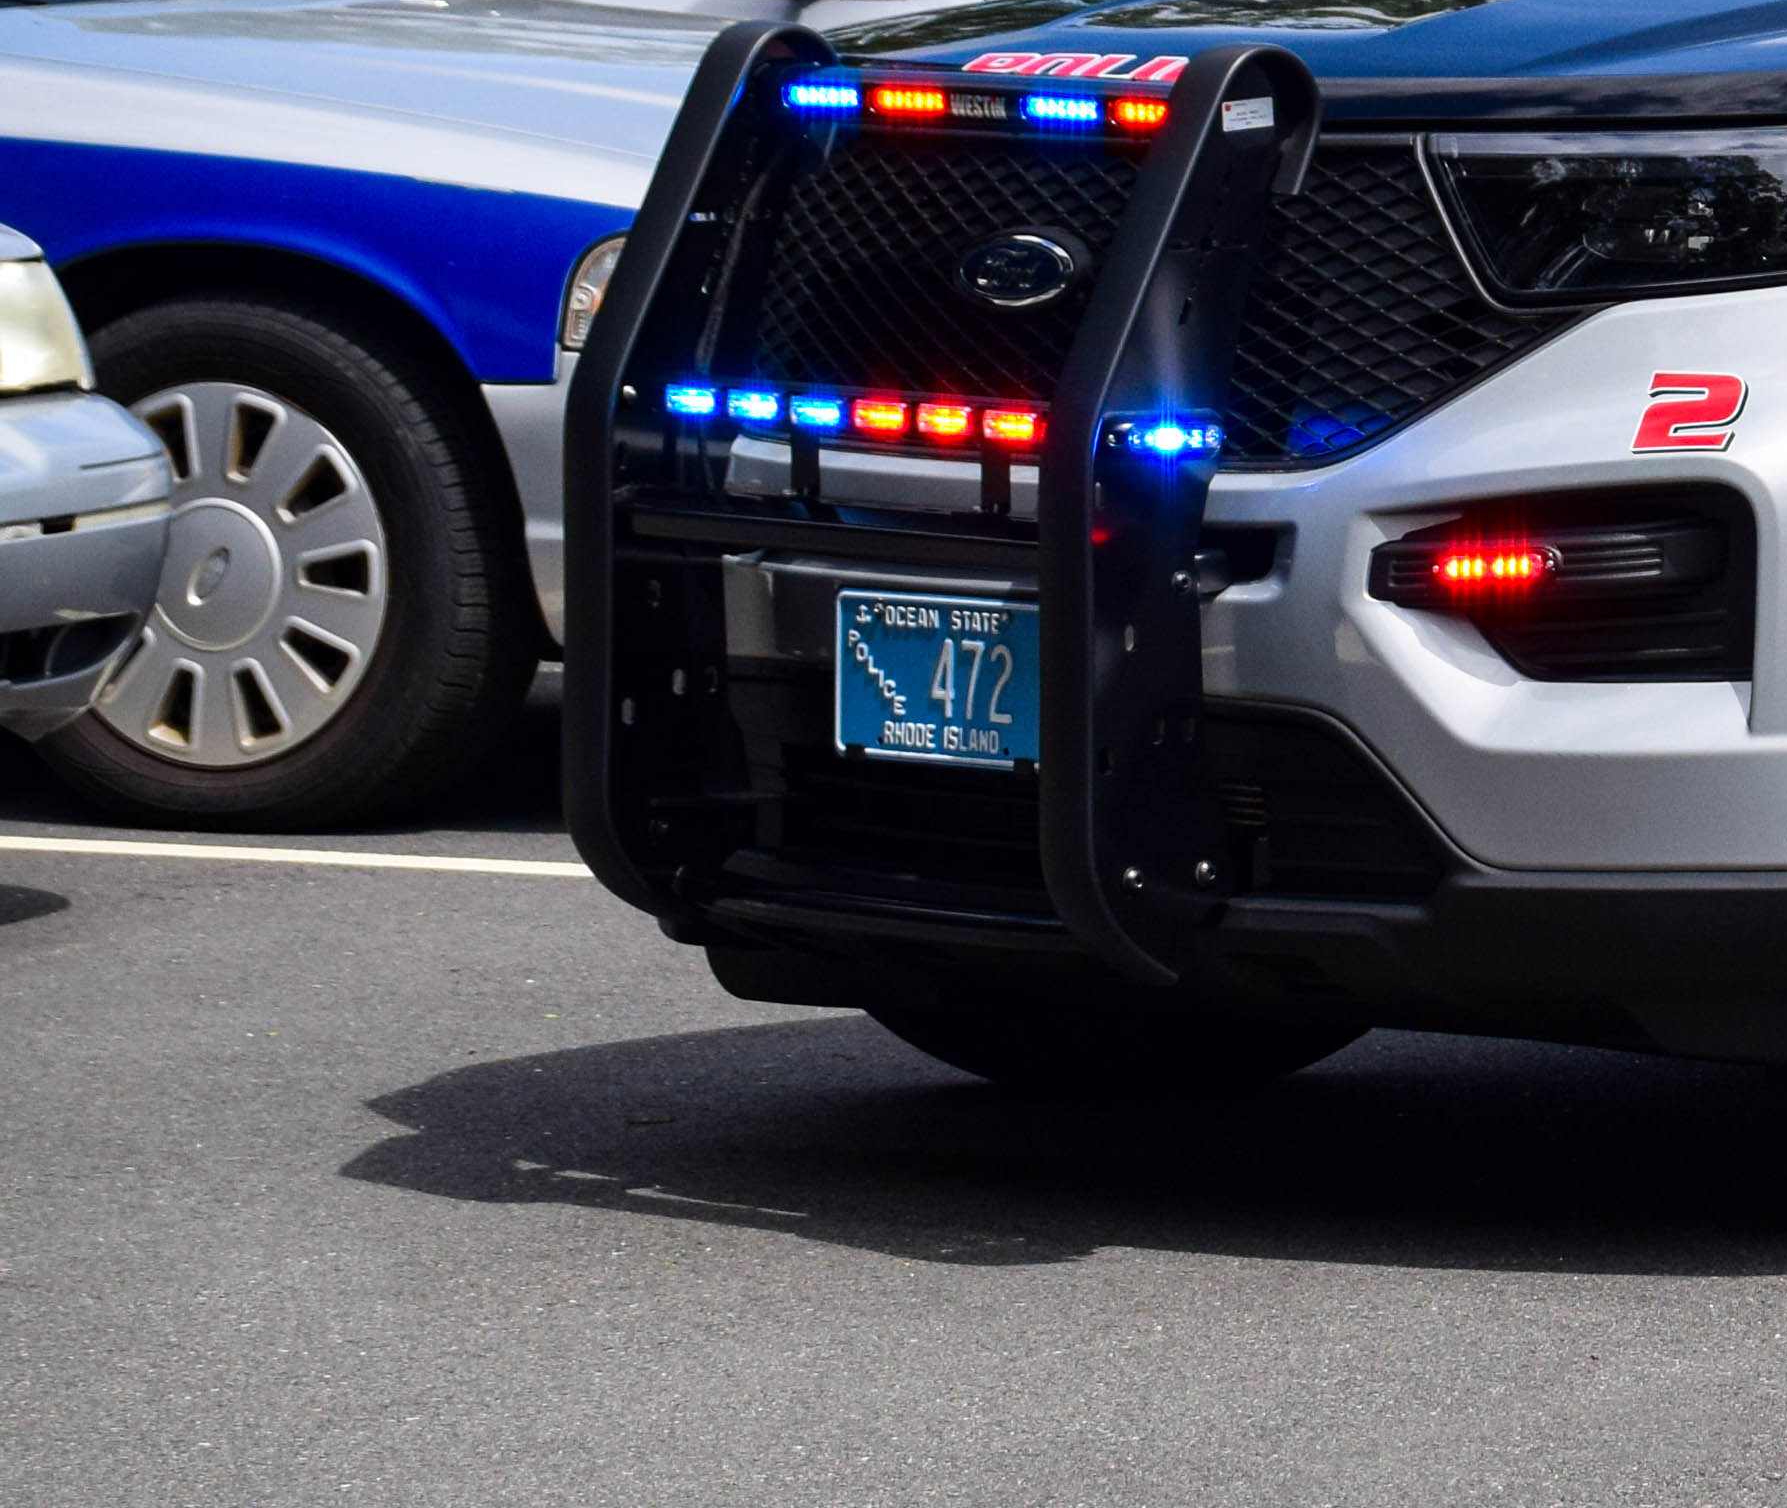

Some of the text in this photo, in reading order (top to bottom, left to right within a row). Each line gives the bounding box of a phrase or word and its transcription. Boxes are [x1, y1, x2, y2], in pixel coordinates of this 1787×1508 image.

[960, 51, 1191, 84] POLI
[1631, 370, 1749, 455] 2
[885, 604, 1001, 635] OCEAN STATE
[848, 629, 908, 716] POLICE
[930, 637, 1014, 724] 472
[883, 720, 1000, 755] RHODE ISLAND
